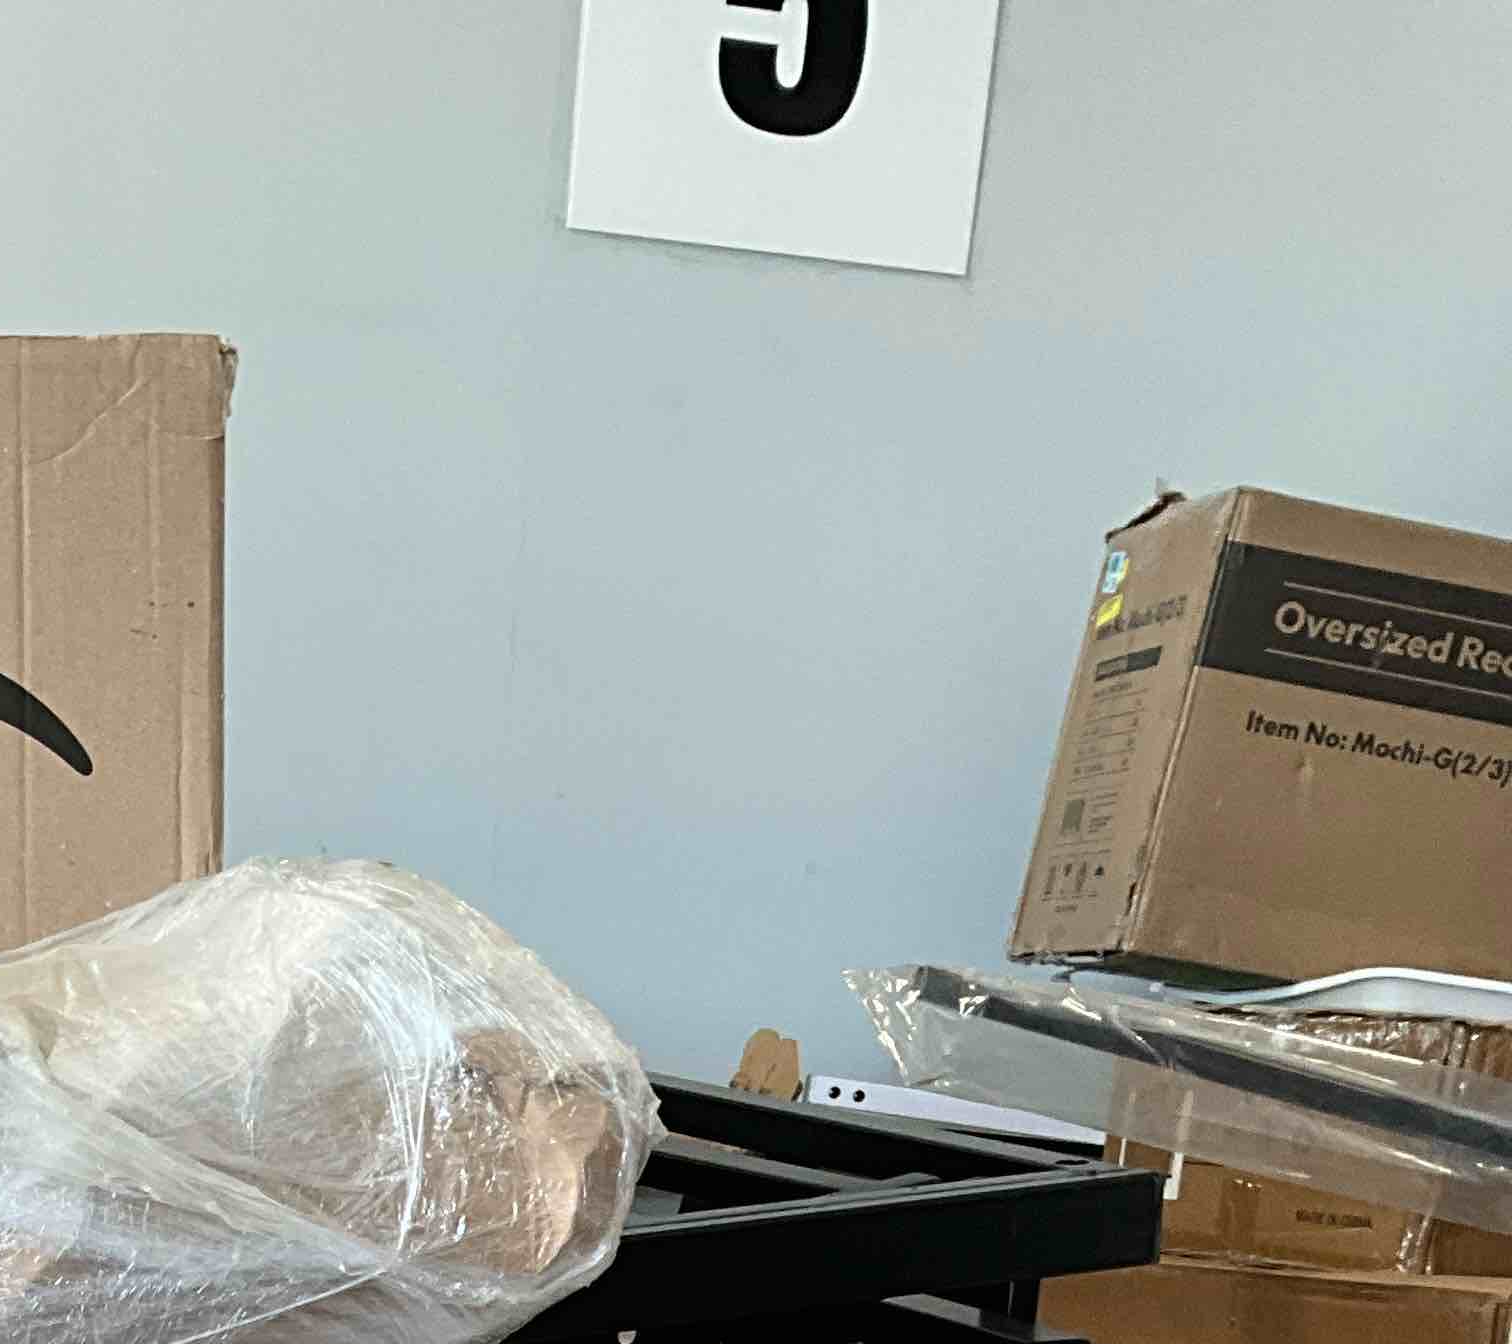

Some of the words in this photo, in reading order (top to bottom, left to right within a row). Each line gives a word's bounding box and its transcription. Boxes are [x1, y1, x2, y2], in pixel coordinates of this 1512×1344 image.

[1274, 600, 1455, 665] Oversized
[1245, 710, 1299, 744] Item
[1305, 723, 1347, 752] No:
